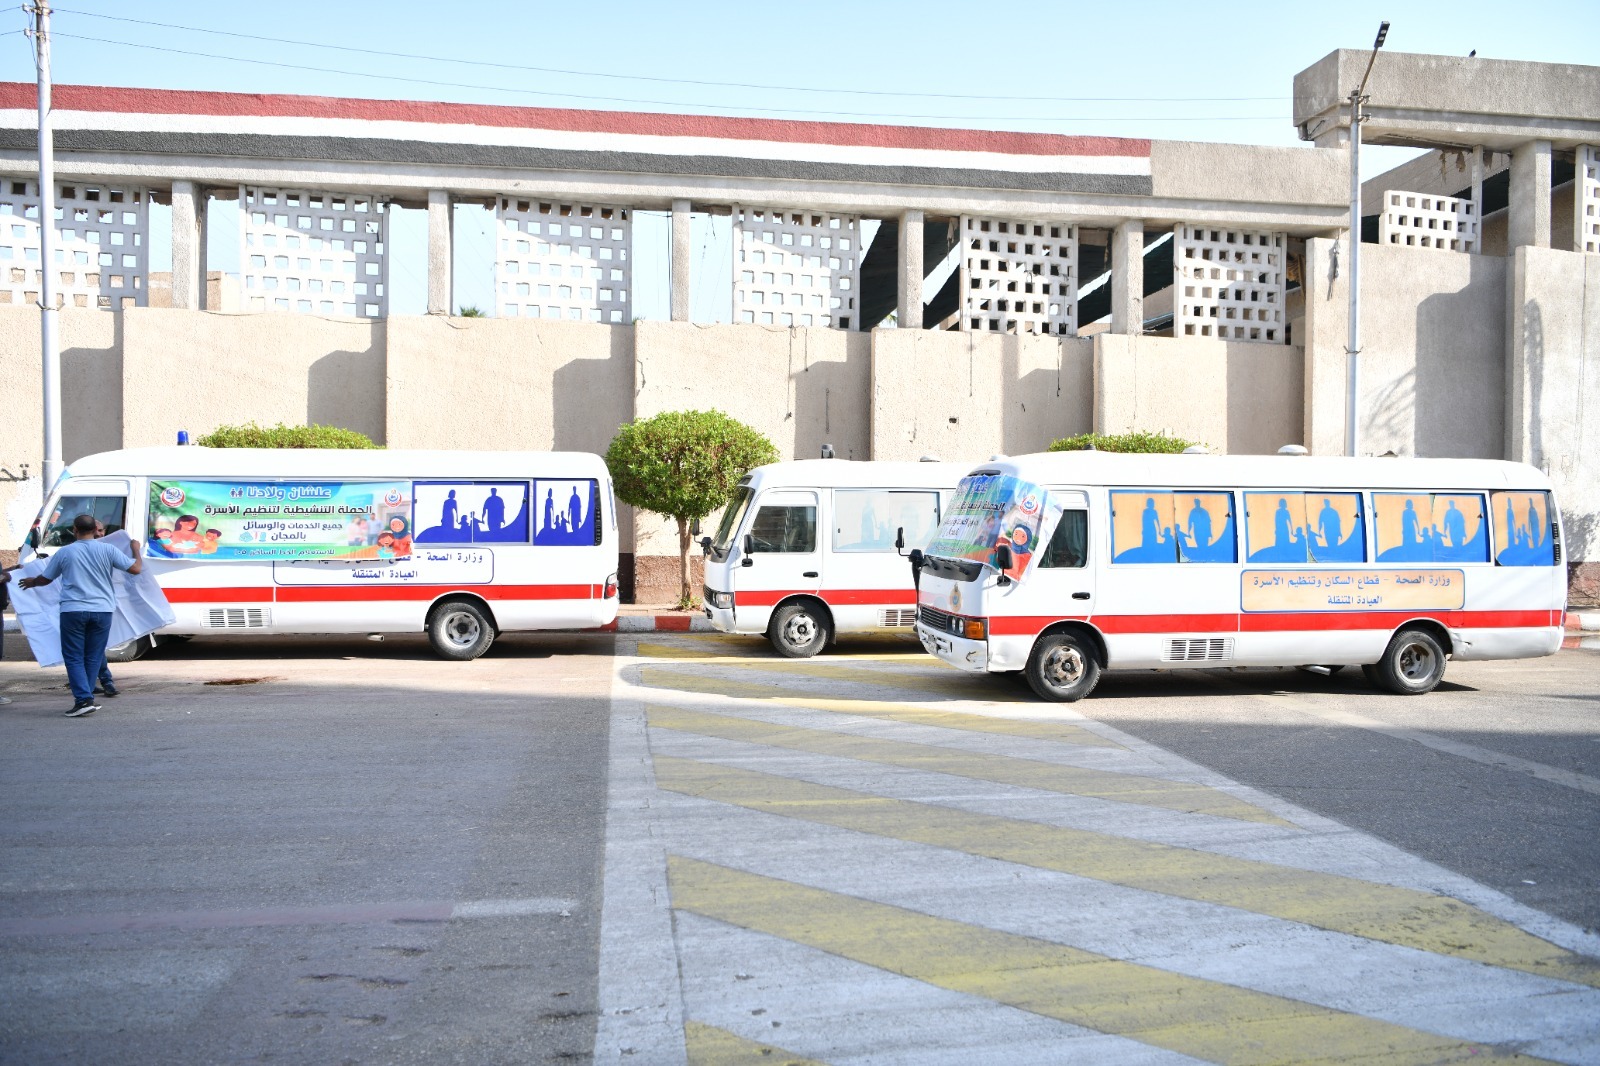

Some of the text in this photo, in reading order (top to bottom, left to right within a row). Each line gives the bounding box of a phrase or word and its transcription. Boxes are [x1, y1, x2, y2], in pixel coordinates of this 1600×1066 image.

[247, 486, 331, 500] علشان ولادنا
[204, 503, 373, 516] الحملة التنشيطية لتنظيم الأسرة
[243, 521, 343, 531] جميع الخدمات والوسائل
[271, 531, 307, 541] بالمجان
[427, 552, 452, 561] الصحة
[457, 553, 483, 563] وزارة
[352, 569, 418, 580] العيادة المتنقلة
[1395, 575, 1425, 584] الصحة
[1288, 576, 1322, 588] وتنظيم
[1325, 576, 1354, 587] السكان
[1357, 575, 1380, 589] قطاع
[1429, 575, 1450, 586] وزارة
[1328, 595, 1382, 606] العيادة المتنقلة
